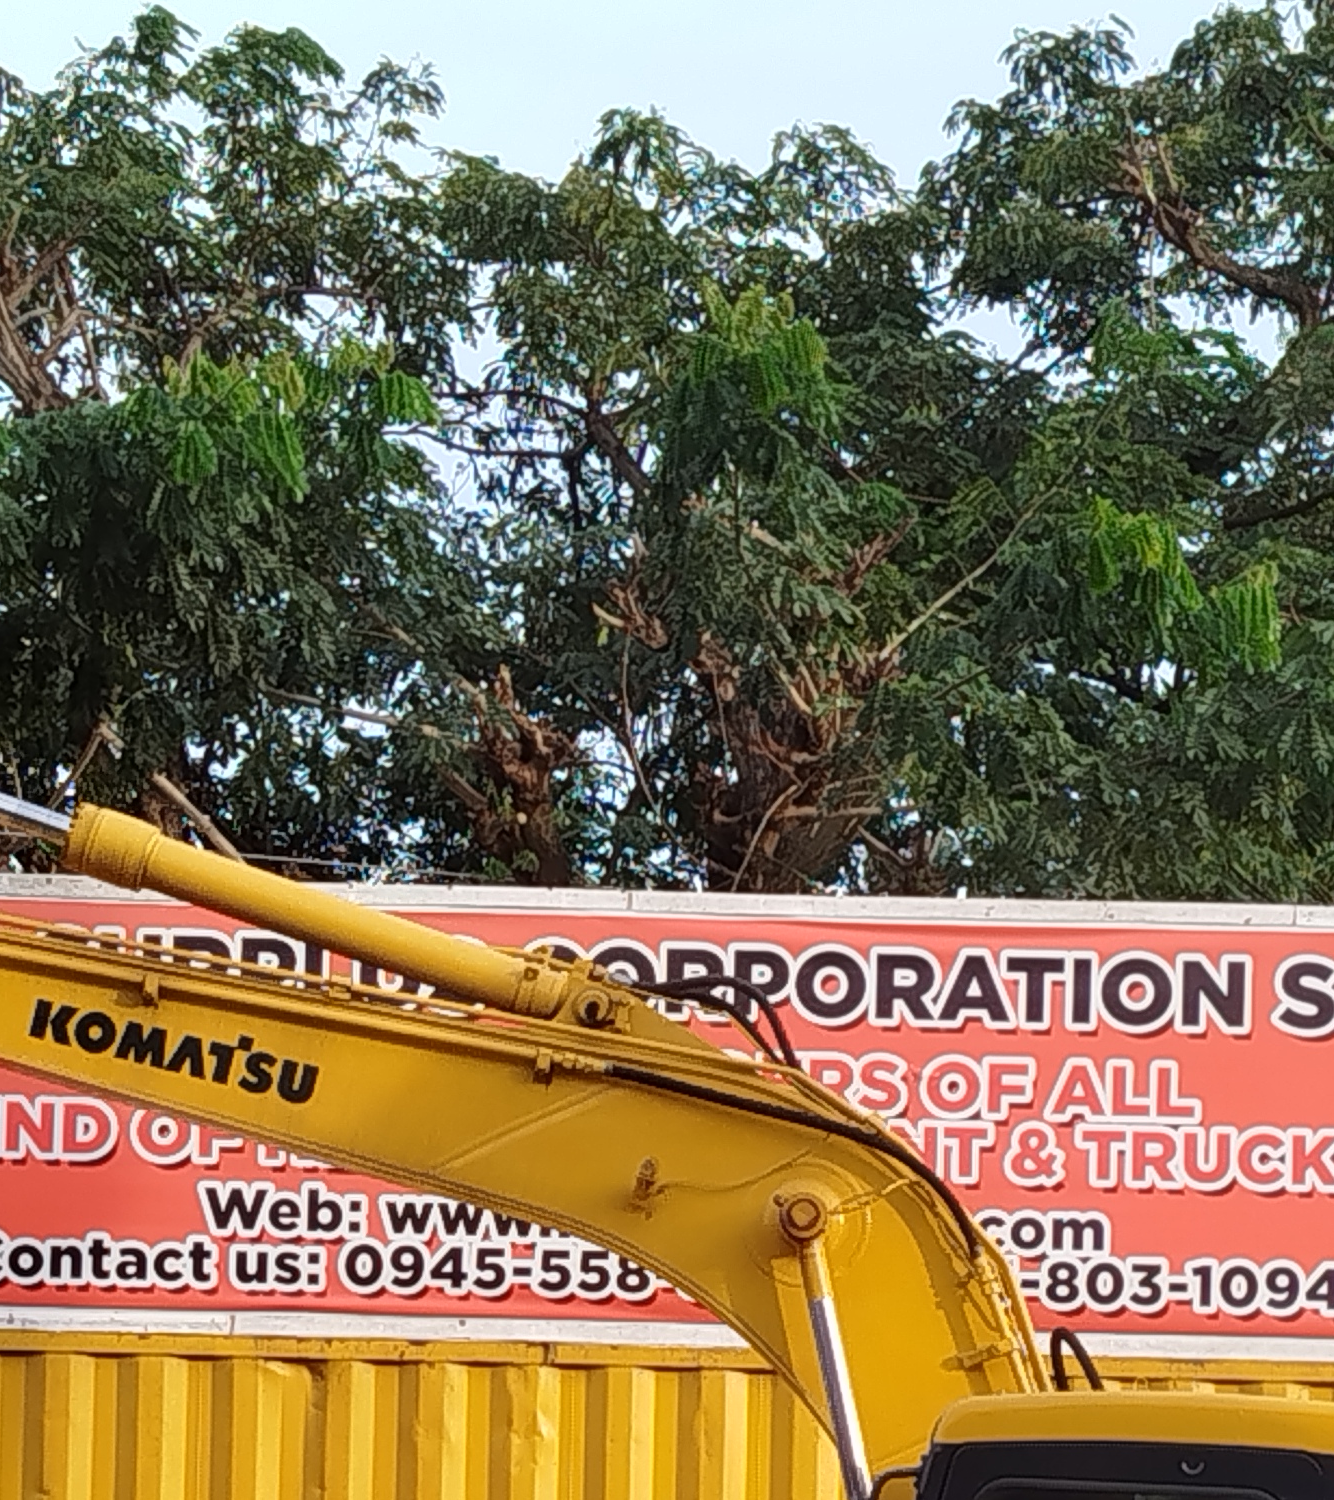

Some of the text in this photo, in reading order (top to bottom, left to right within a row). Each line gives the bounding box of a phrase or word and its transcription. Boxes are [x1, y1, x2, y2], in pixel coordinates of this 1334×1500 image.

[529, 945, 1248, 1028] RPORATION
[28, 999, 319, 1104] KOMATSU
[926, 1058, 1031, 1113] OF
[1053, 1062, 1198, 1120] ALL
[1009, 1125, 1061, 1180] &
[206, 1186, 363, 1233] Web:
[234, 1247, 319, 1286] us:
